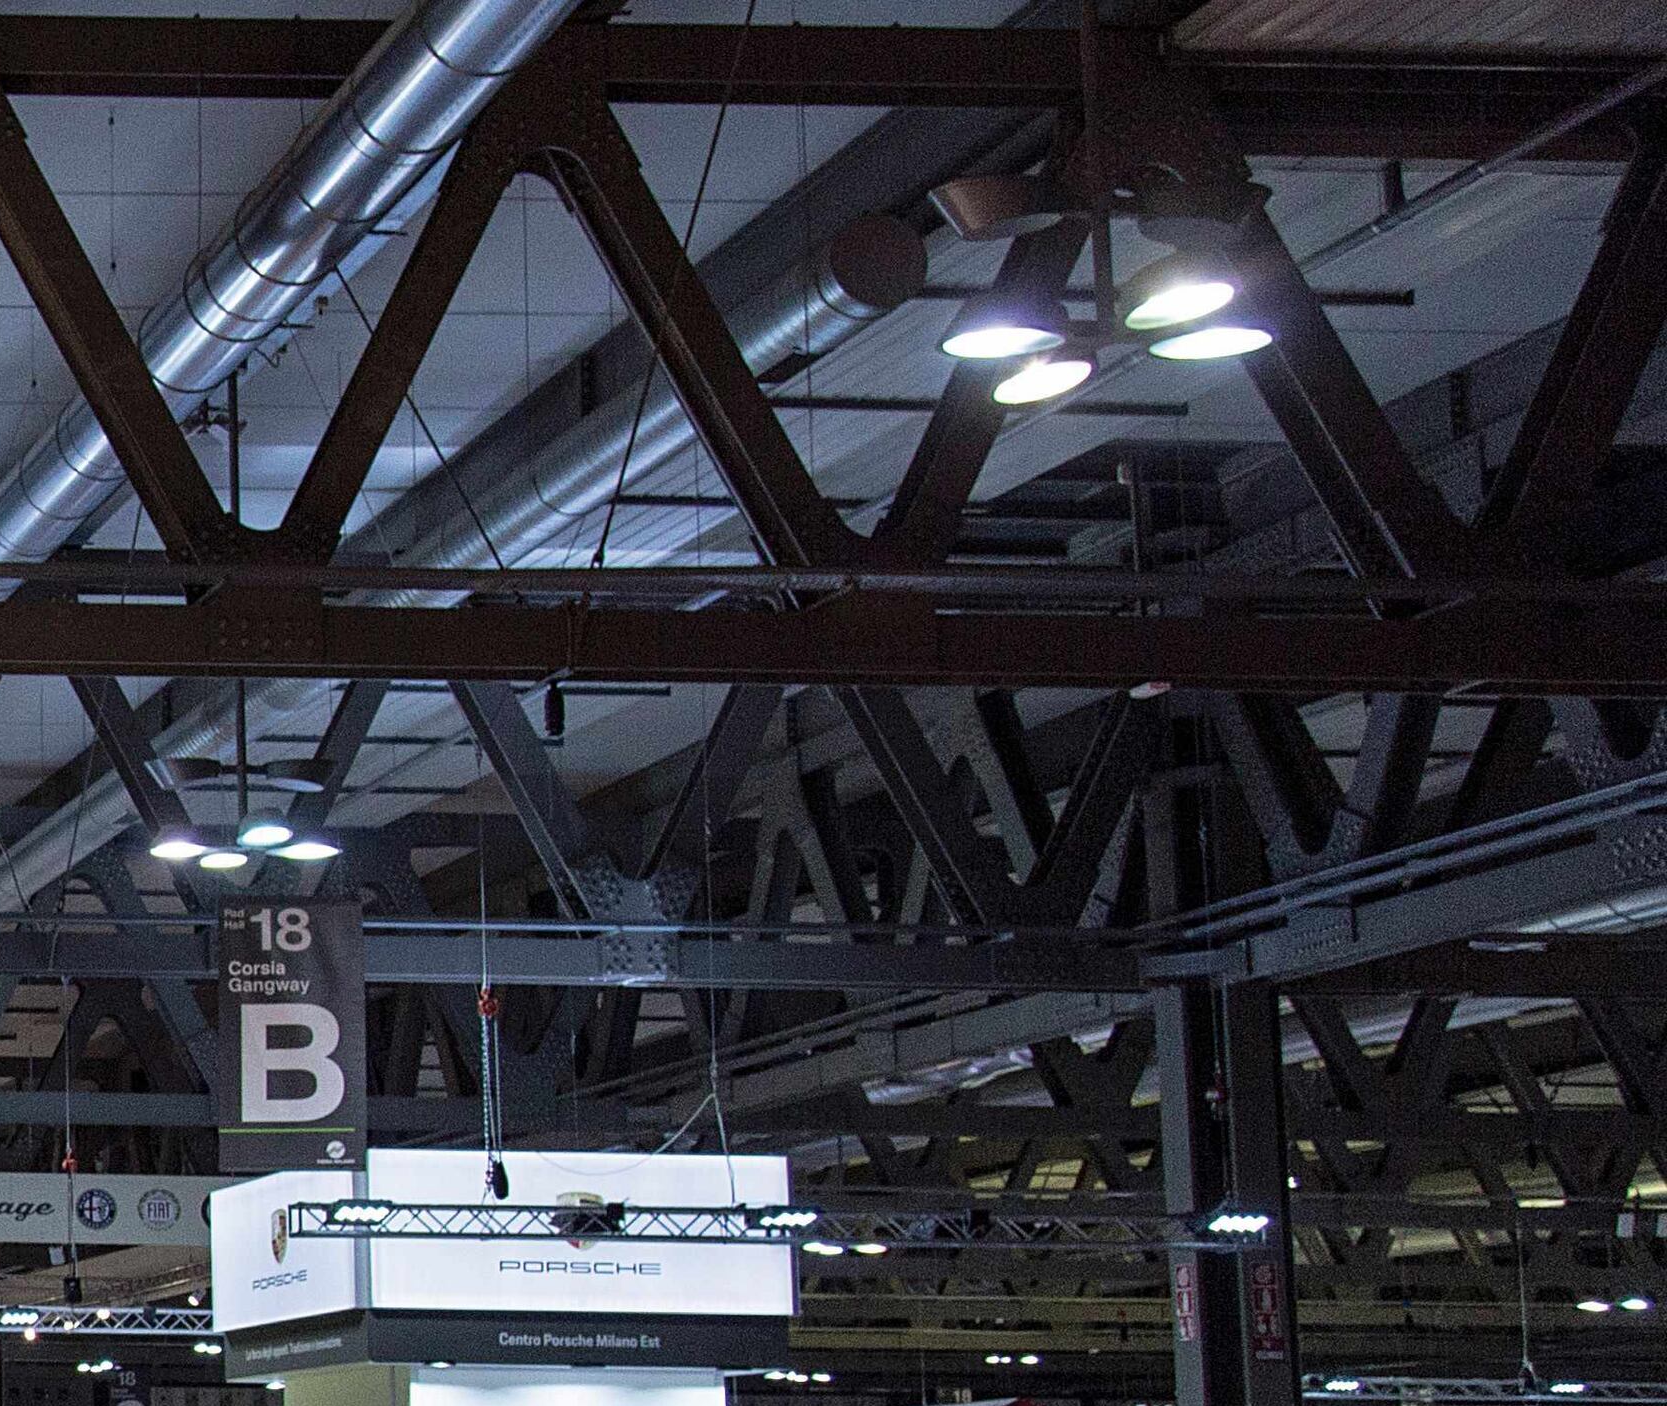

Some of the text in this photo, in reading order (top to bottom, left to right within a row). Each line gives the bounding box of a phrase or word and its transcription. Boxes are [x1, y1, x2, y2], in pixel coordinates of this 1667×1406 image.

[250, 907, 312, 952] 18
[228, 959, 286, 976] Corsia
[228, 977, 310, 995] Gangway
[240, 1003, 345, 1123] B
[146, 1201, 171, 1217] FIAT
[499, 1260, 661, 1275] PORSCHE
[252, 1269, 307, 1292] PORSCHE
[499, 1332, 660, 1348] Centro Porsche Milano Est
